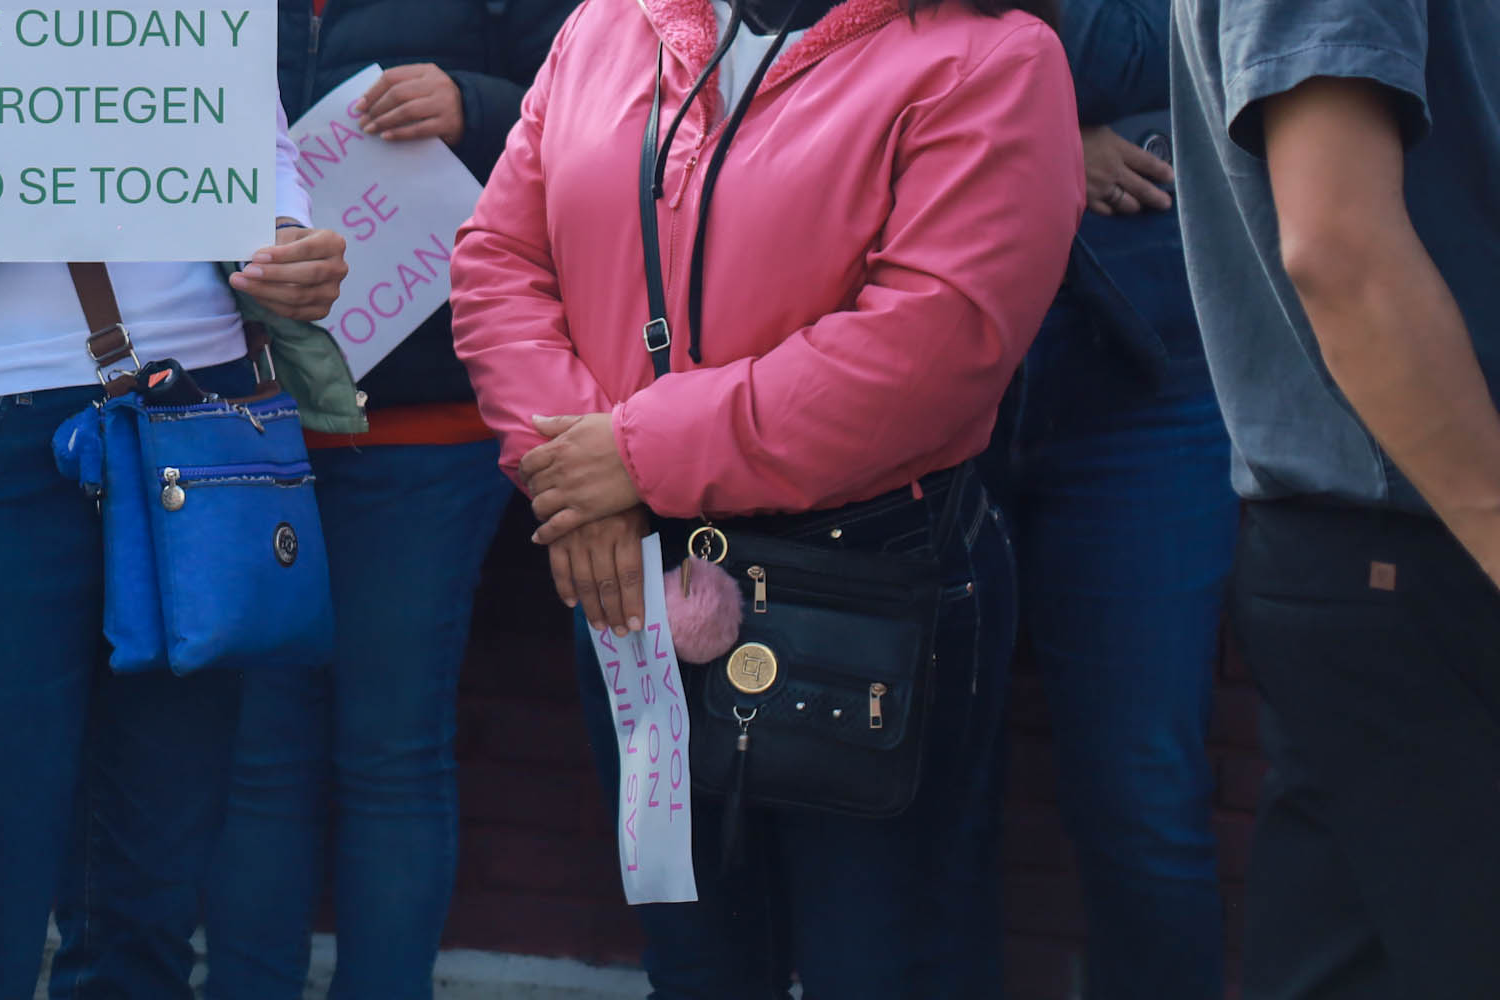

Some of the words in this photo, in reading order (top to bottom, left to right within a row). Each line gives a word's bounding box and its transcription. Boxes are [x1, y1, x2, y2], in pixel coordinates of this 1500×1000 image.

[15, 9, 206, 48] CUIDAN
[221, 10, 250, 48] Y
[19, 167, 77, 205] SE
[89, 167, 259, 205] TOCAN
[341, 183, 400, 242] SE
[328, 233, 451, 350] OCAN
[631, 635, 657, 705] SE
[647, 622, 684, 824] TOCAN
[647, 723, 661, 808] NO
[626, 773, 639, 872] LAS
